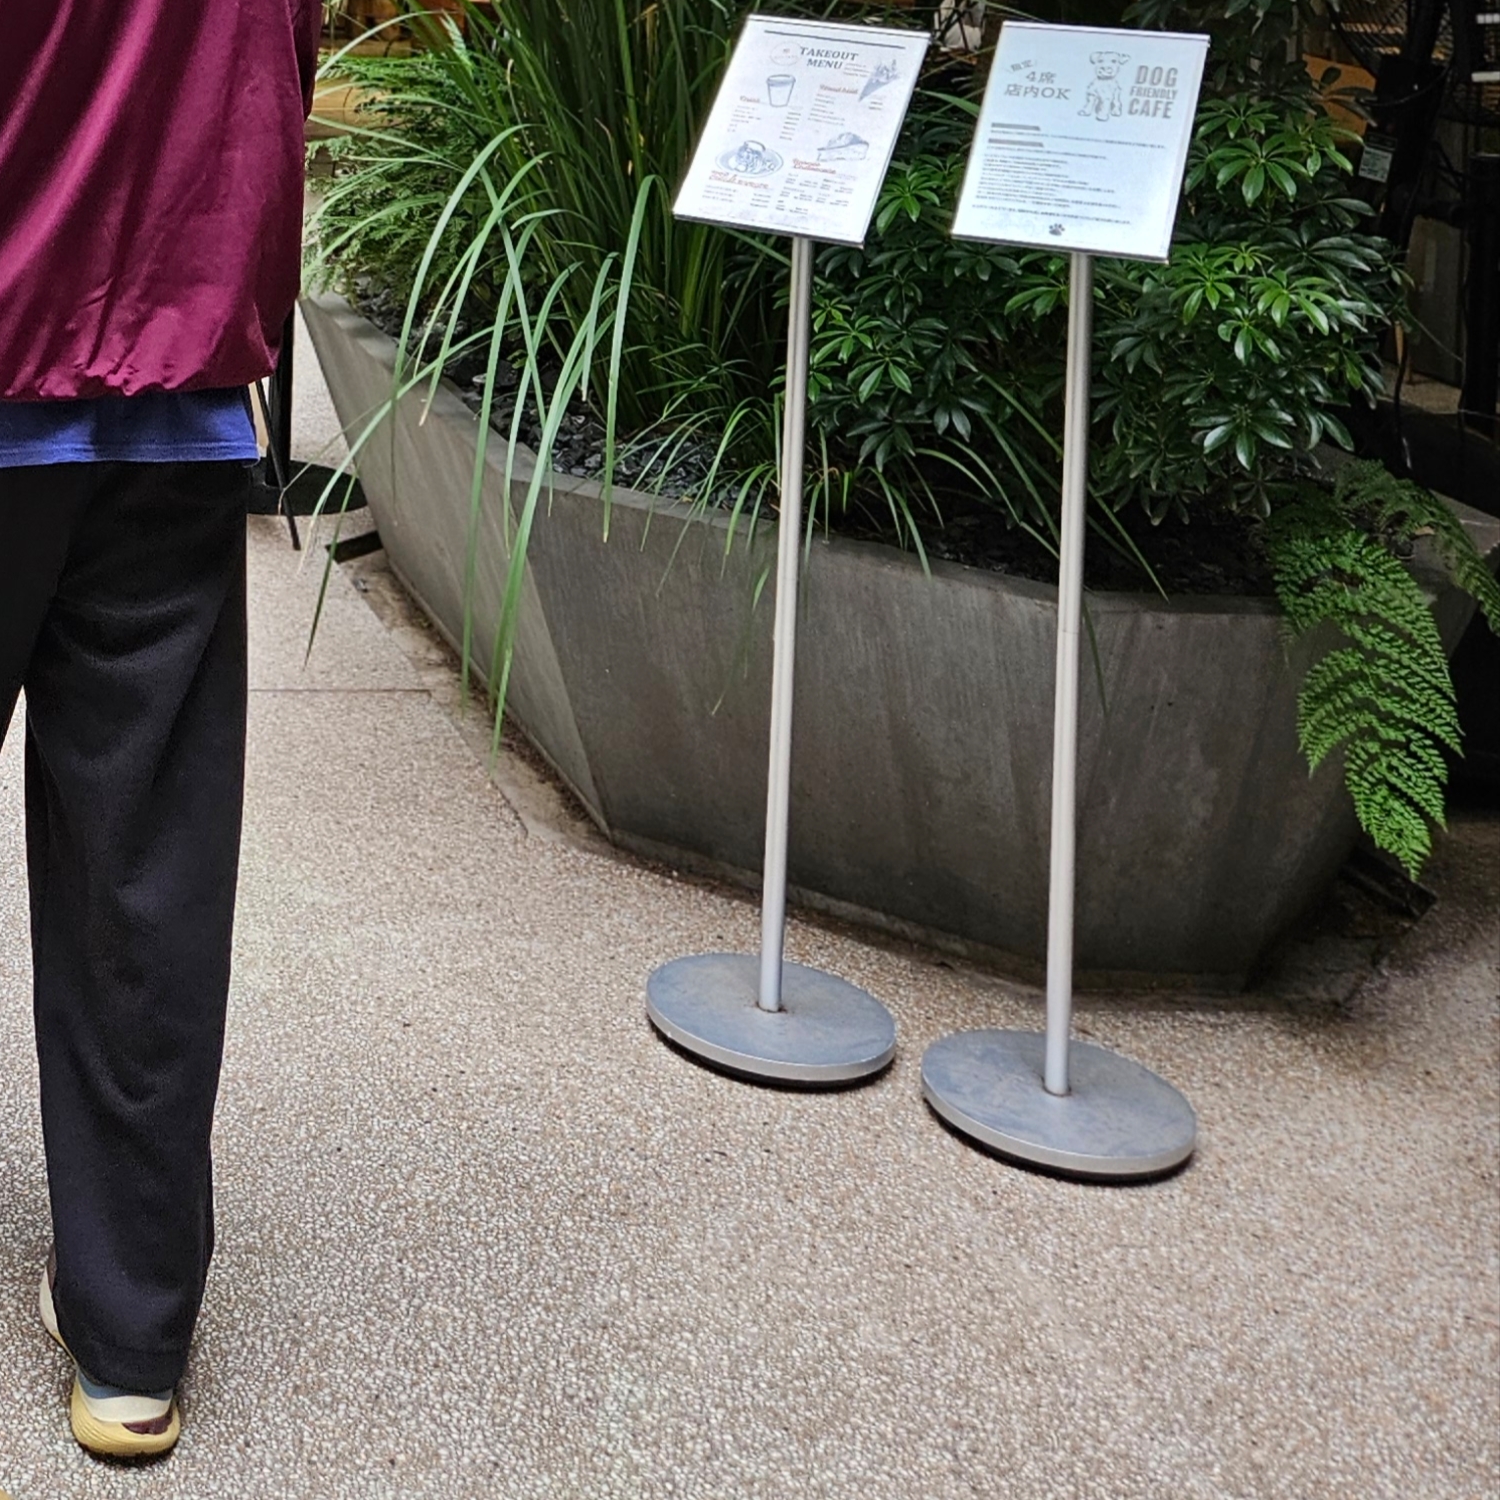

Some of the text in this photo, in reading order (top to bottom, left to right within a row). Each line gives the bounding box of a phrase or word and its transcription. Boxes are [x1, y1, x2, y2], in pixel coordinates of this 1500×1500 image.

[799, 46, 859, 62] TAKEOUT
[806, 58, 844, 71] MENU
[1135, 65, 1179, 87] DOG
[1004, 84, 1072, 100] 店内OK
[1129, 87, 1178, 101] FRIENDLY
[1127, 100, 1174, 119] CAFE
